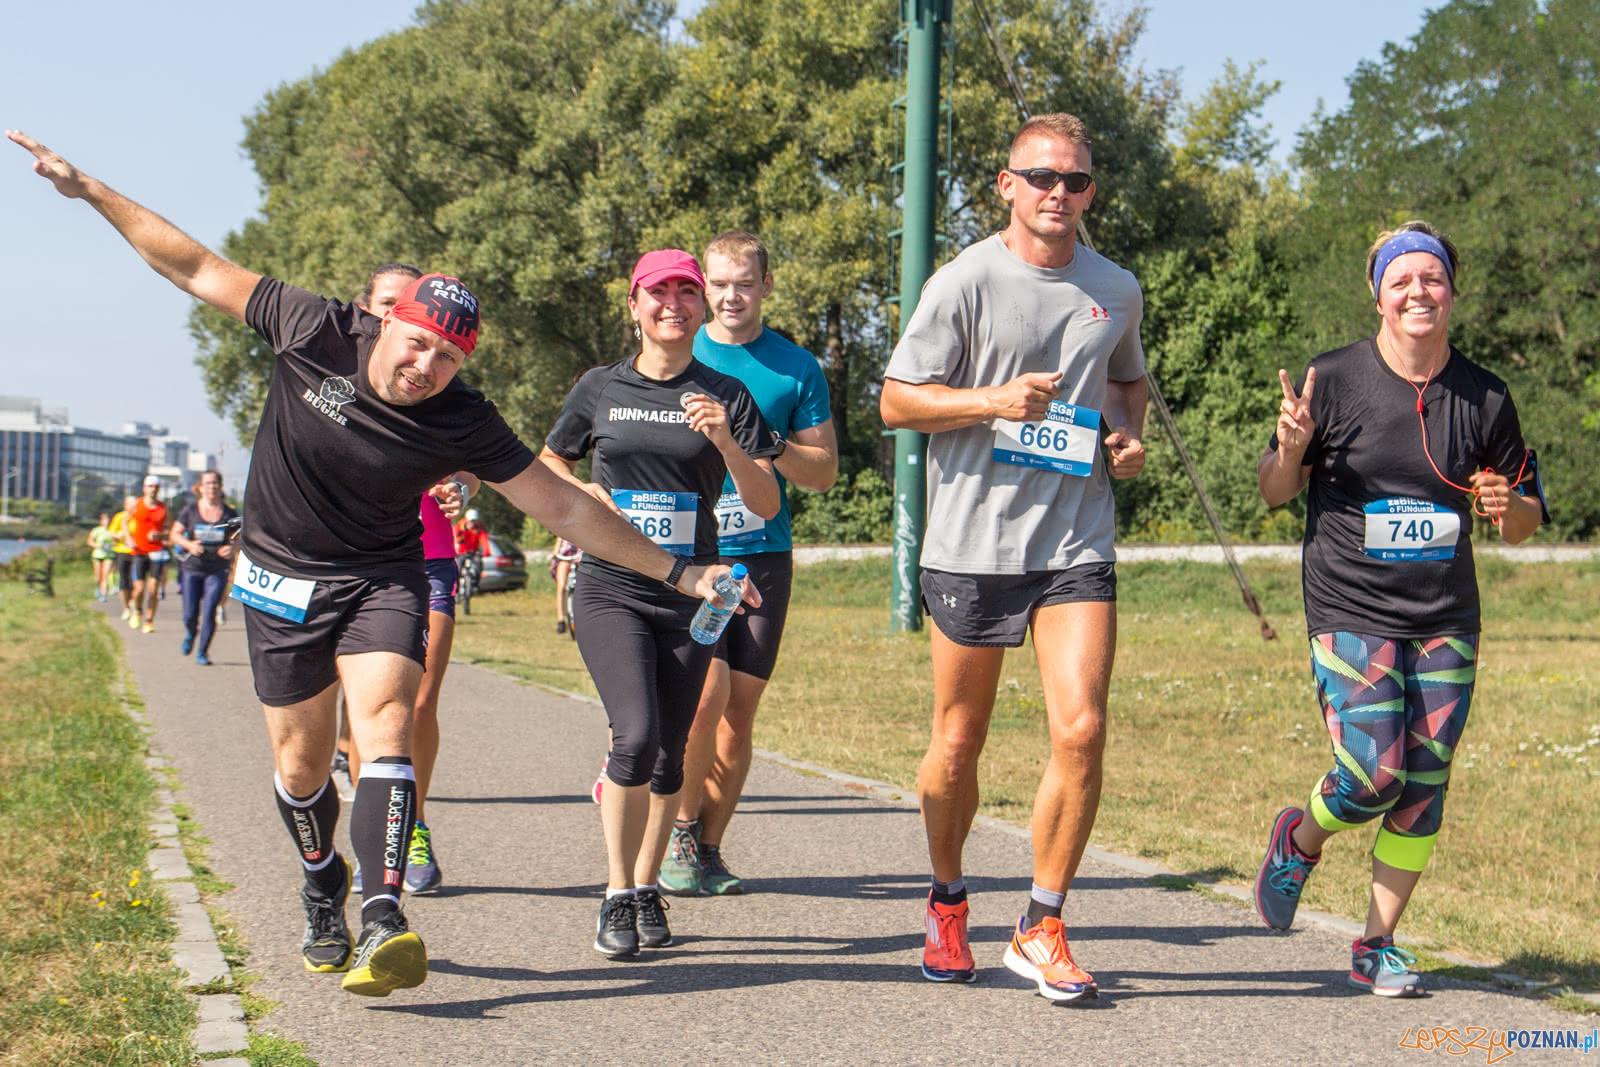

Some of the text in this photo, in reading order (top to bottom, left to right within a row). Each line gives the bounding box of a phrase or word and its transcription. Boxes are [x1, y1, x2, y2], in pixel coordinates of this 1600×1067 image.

[429, 280, 477, 308] RACE
[433, 288, 475, 313] RUN
[1019, 423, 1069, 452] 666
[631, 493, 677, 505] zaBIEGaj
[1388, 519, 1434, 542] 740
[247, 562, 288, 592] 567
